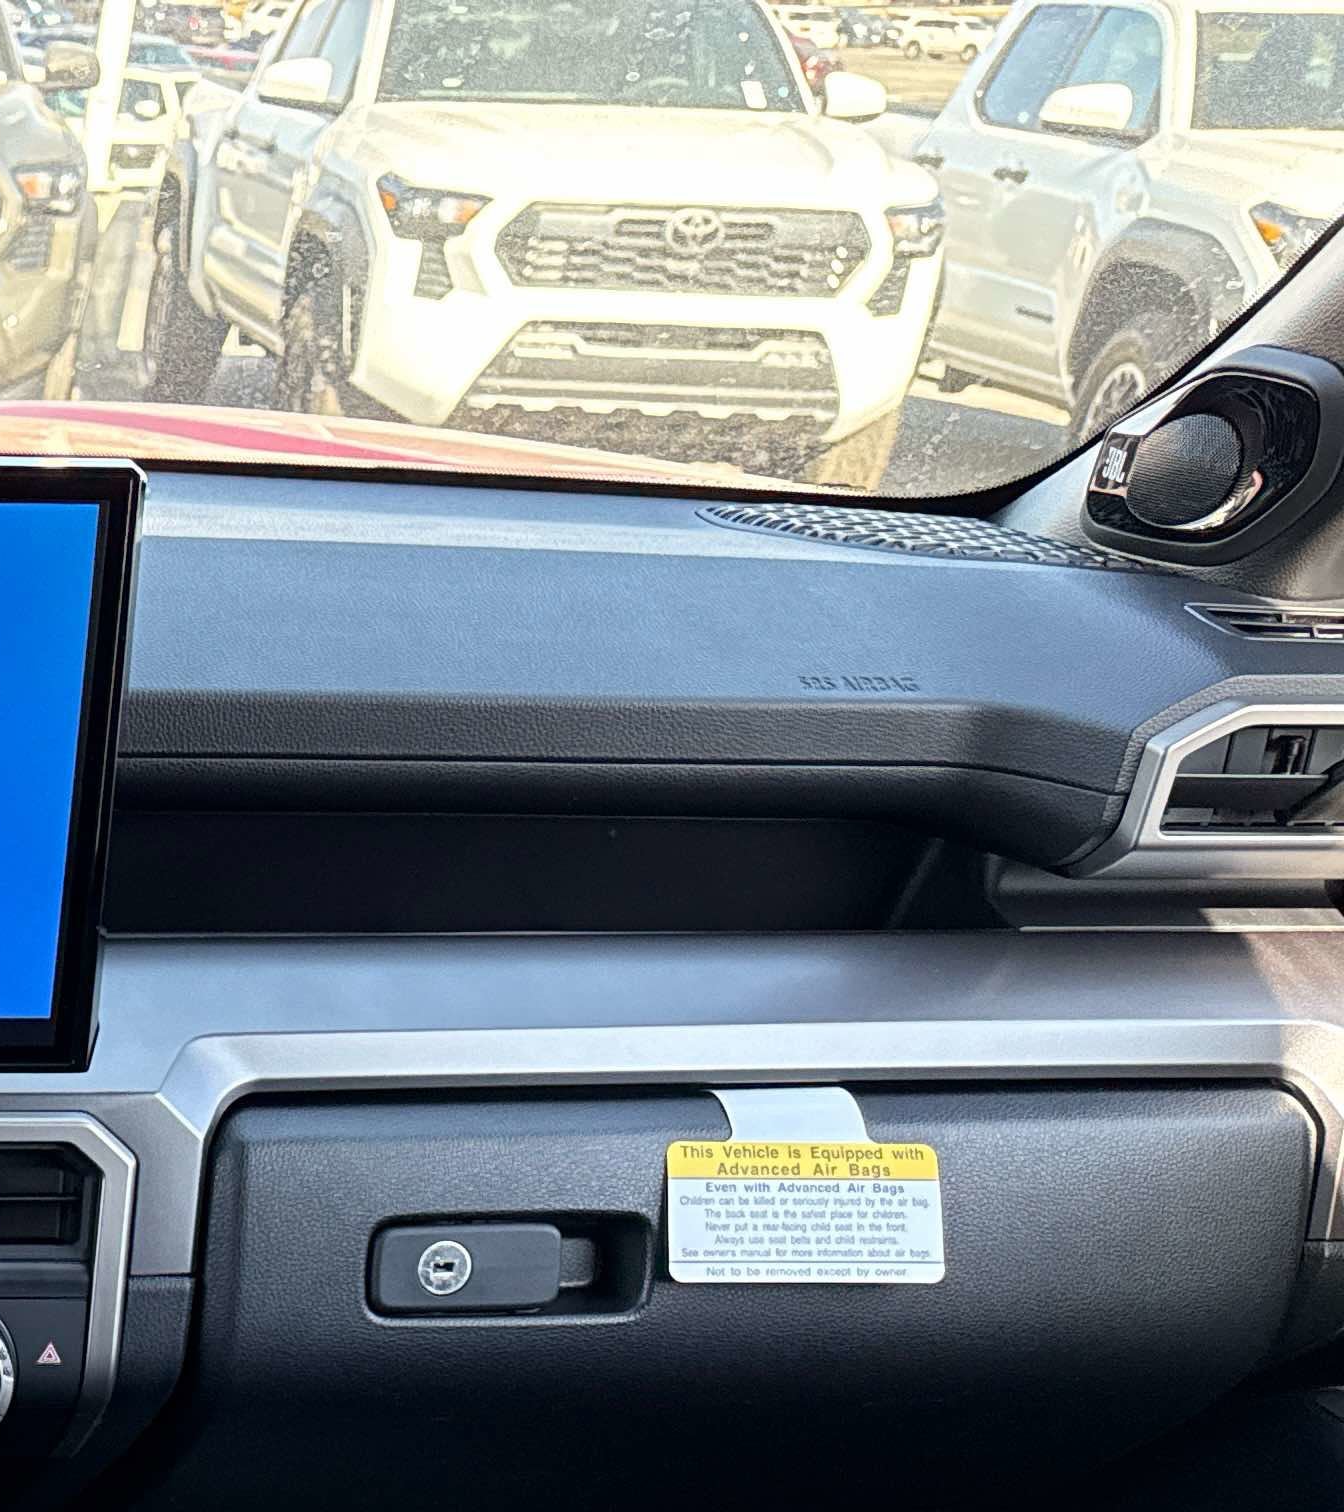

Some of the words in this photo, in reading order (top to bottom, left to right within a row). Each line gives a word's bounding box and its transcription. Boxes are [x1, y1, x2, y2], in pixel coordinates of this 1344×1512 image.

[1102, 446, 1127, 484] JBL
[680, 1146, 714, 1159] This
[723, 1145, 779, 1160] Vehicle
[788, 1145, 801, 1159] is
[811, 1146, 883, 1163] Equipped
[892, 1146, 924, 1161] with
[717, 1163, 801, 1176] Advanced
[813, 1163, 837, 1176] Air
[849, 1163, 891, 1179] Bags
[705, 1182, 737, 1193] Even
[744, 1182, 771, 1193] with
[777, 1182, 840, 1193] Advanced
[847, 1183, 865, 1193] Air
[872, 1183, 905, 1195] Bags
[679, 1196, 715, 1207] Children
[719, 1198, 735, 1207] can
[738, 1197, 750, 1207] be
[753, 1197, 775, 1207] killed
[779, 1198, 789, 1207] or
[792, 1197, 830, 1208] seriously
[833, 1197, 861, 1208] injured
[865, 1197, 876, 1208] by
[880, 1197, 893, 1207] the
[898, 1198, 908, 1207] air
[704, 1209, 722, 1219] The
[725, 1209, 746, 1219] back
[784, 1209, 797, 1219] the
[801, 1209, 826, 1219] safest
[830, 1210, 853, 1221] place
[857, 1209, 869, 1219] for
[872, 1210, 908, 1220] children.
[705, 1222, 731, 1232] Never
[735, 1222, 749, 1233] put
[762, 1222, 807, 1233] rear-facing
[811, 1222, 831, 1232] child
[835, 1223, 853, 1232] seat
[857, 1222, 865, 1232] in
[869, 1223, 882, 1232] the
[714, 1235, 745, 1246] Always
[749, 1236, 764, 1245] use
[769, 1236, 787, 1245] seat
[790, 1235, 811, 1245] belts
[815, 1236, 831, 1245] and
[835, 1235, 855, 1245] child
[682, 1248, 699, 1258] See
[740, 1248, 772, 1258] manual
[775, 1248, 788, 1258] for
[791, 1250, 813, 1258] more
[817, 1248, 864, 1258] information
[867, 1248, 891, 1258] about
[895, 1249, 906, 1258] air
[706, 1267, 725, 1277] Not
[731, 1267, 741, 1277] to
[747, 1267, 760, 1277] be
[765, 1267, 811, 1277] removed
[817, 1267, 851, 1278] except
[856, 1268, 869, 1278] by
